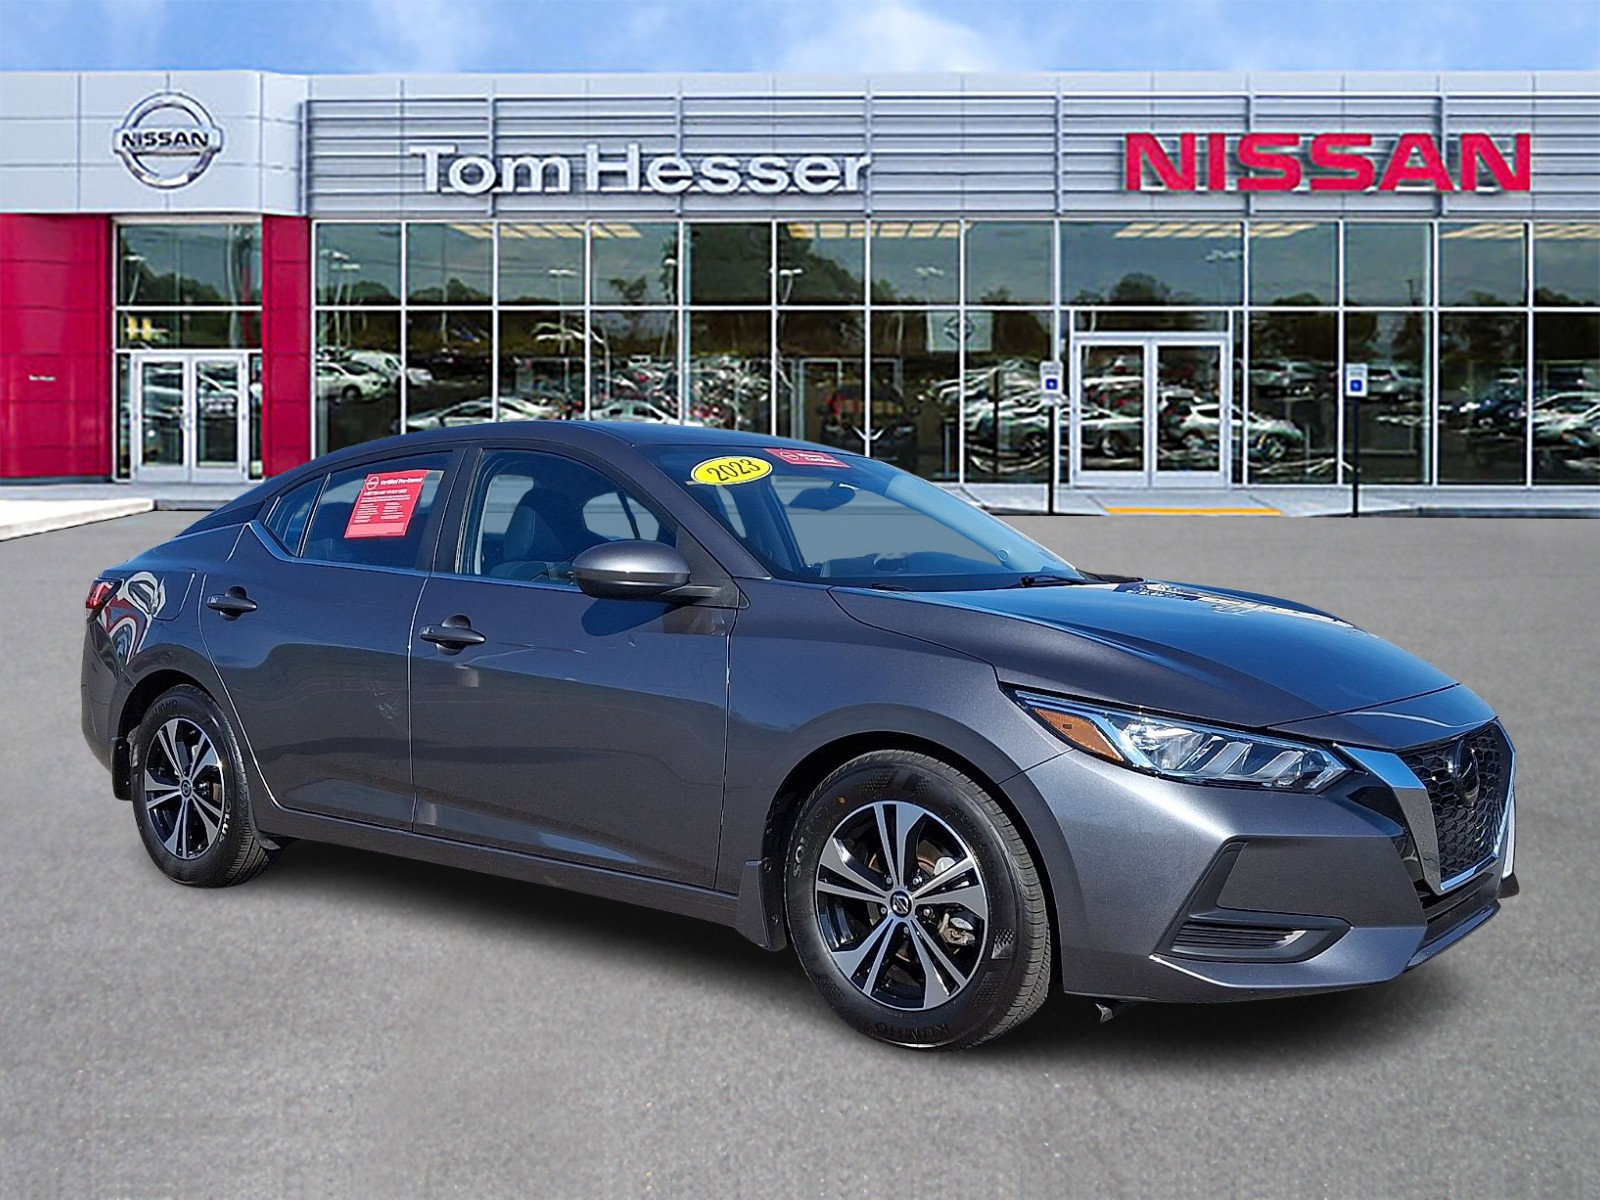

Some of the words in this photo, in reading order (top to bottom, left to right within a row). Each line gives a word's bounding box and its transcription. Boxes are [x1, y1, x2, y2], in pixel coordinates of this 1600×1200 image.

[121, 131, 210, 147] NISSAN
[409, 143, 571, 194] Tom
[585, 142, 871, 194] Hesser
[1125, 132, 1531, 191] NISSAN
[706, 459, 761, 481] 2023
